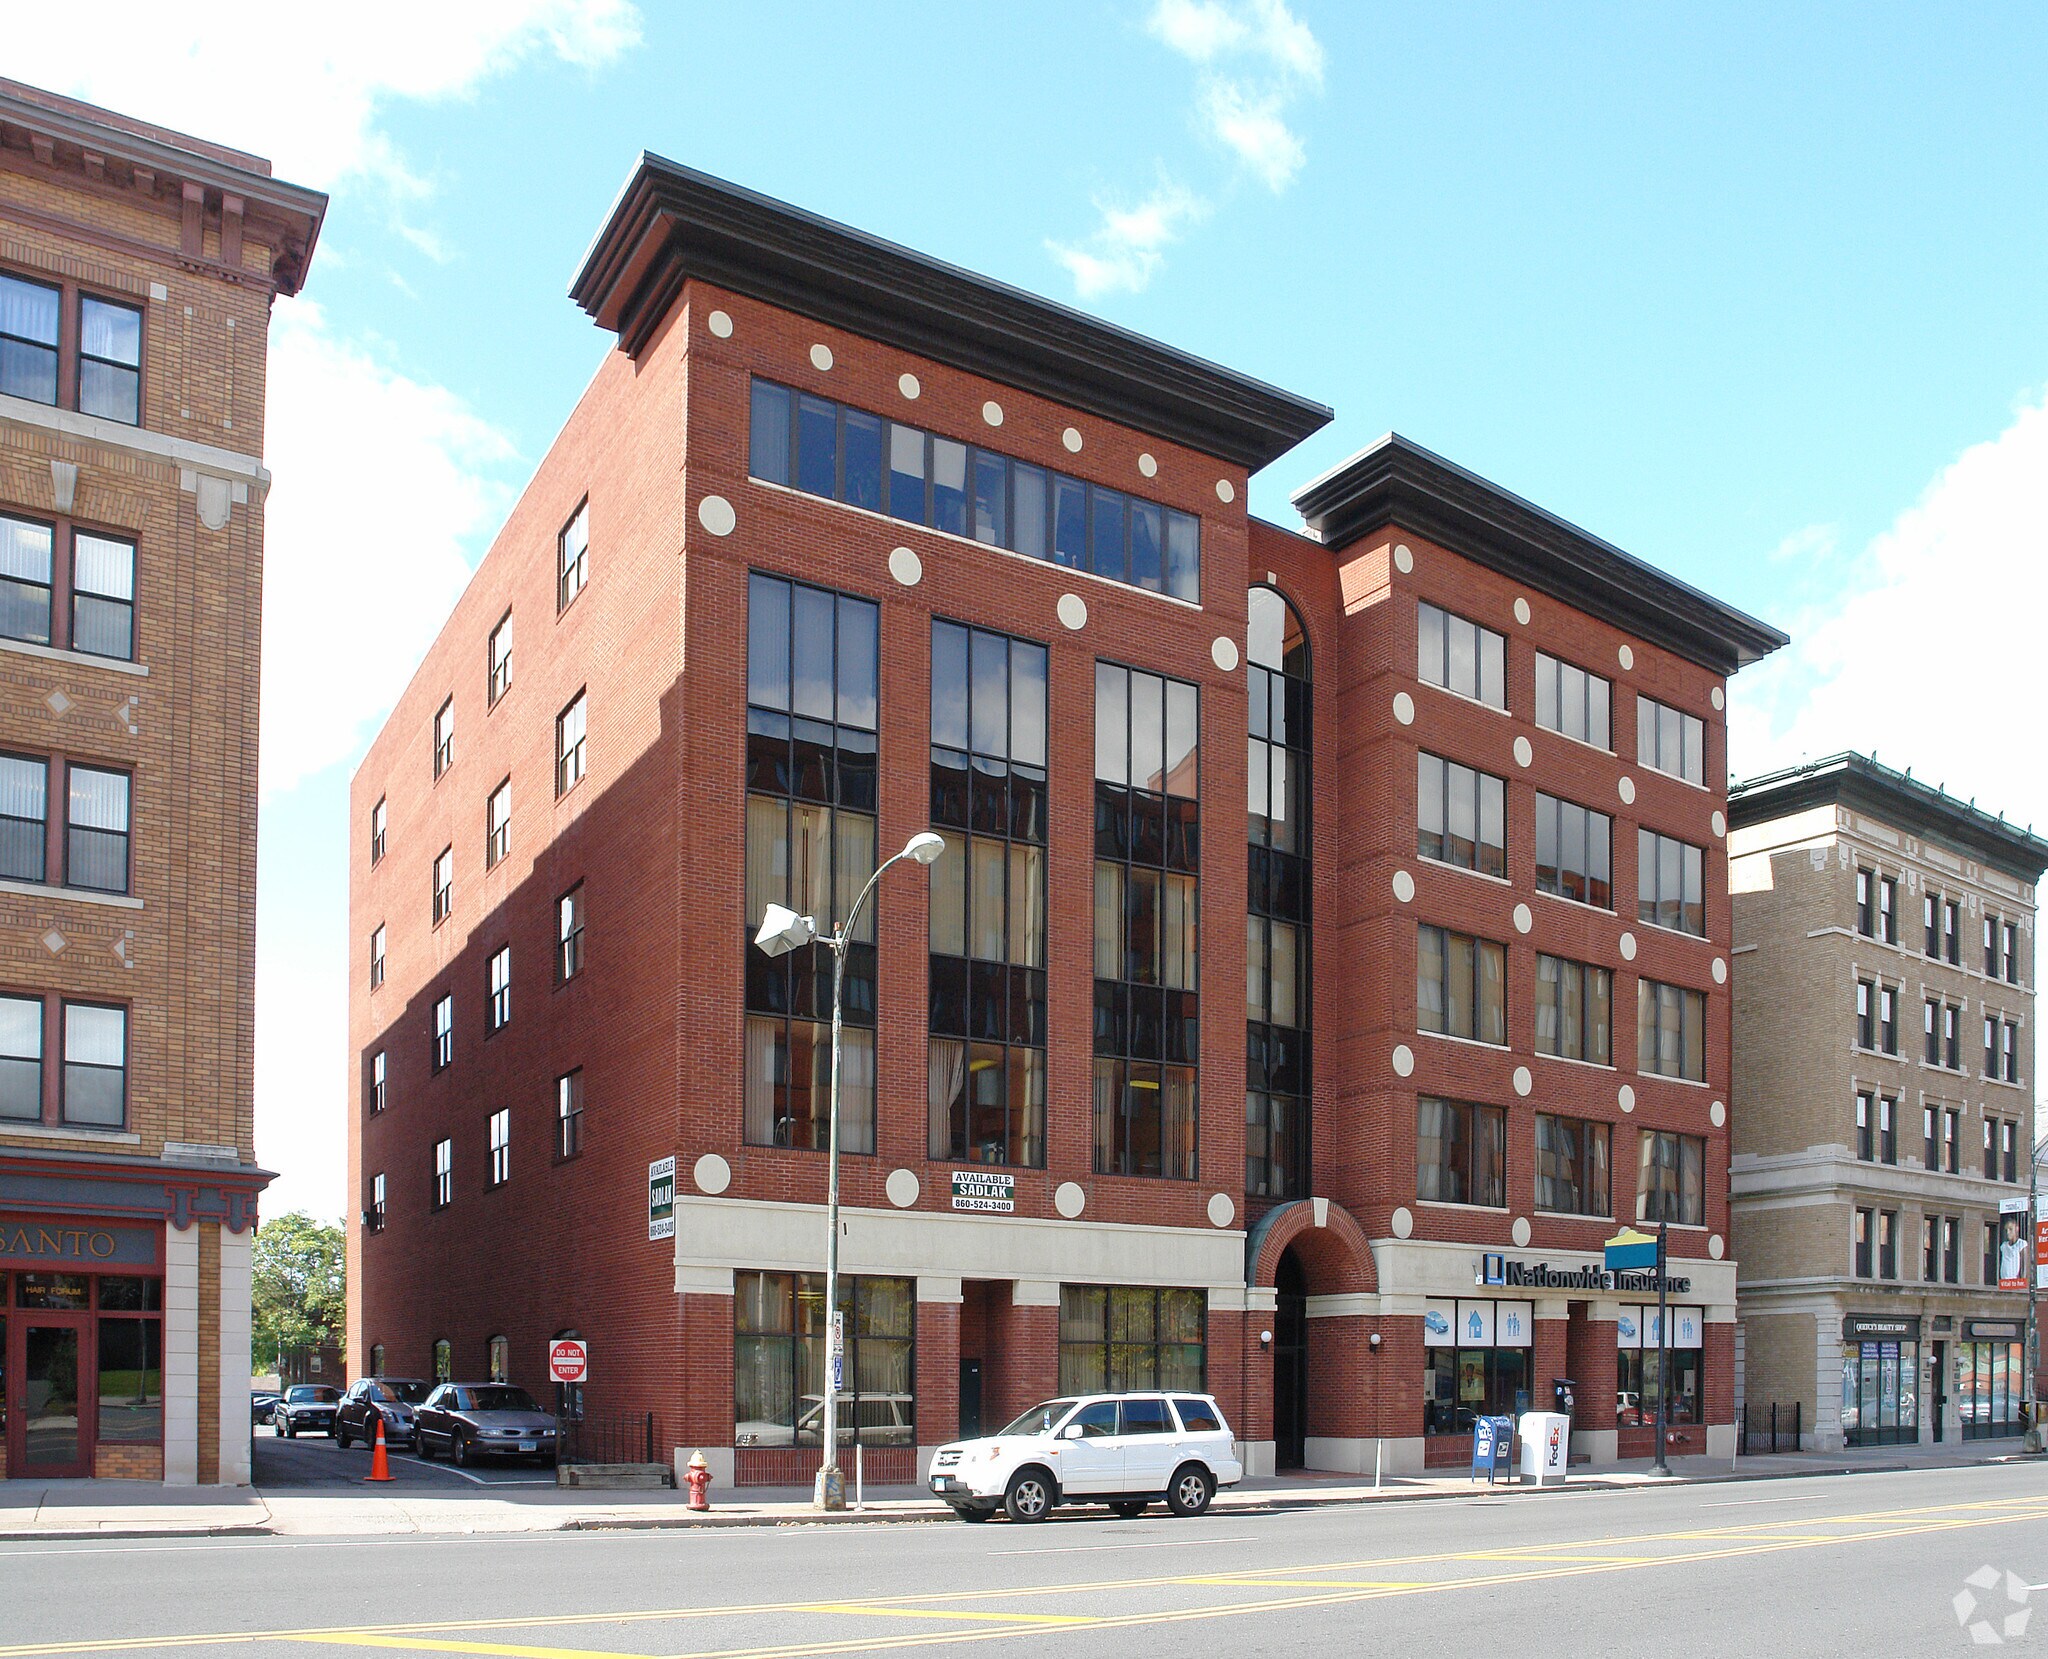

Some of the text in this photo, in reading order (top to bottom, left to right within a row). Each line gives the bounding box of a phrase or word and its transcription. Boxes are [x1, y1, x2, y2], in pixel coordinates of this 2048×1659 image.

[650, 1160, 674, 1177] AVAILABLE
[955, 1173, 1011, 1185] AVAILABLE
[651, 1184, 673, 1208] SADLAK
[959, 1183, 1007, 1198] SADLAK
[955, 1199, 1011, 1211] 860-524-3400
[1506, 1261, 1612, 1290] Nationwide
[26, 1286, 81, 1296] HAIR FORUM
[567, 1349, 581, 1357] NOT
[558, 1366, 579, 1374] ENTER
[1549, 1427, 1560, 1467] FedEx
